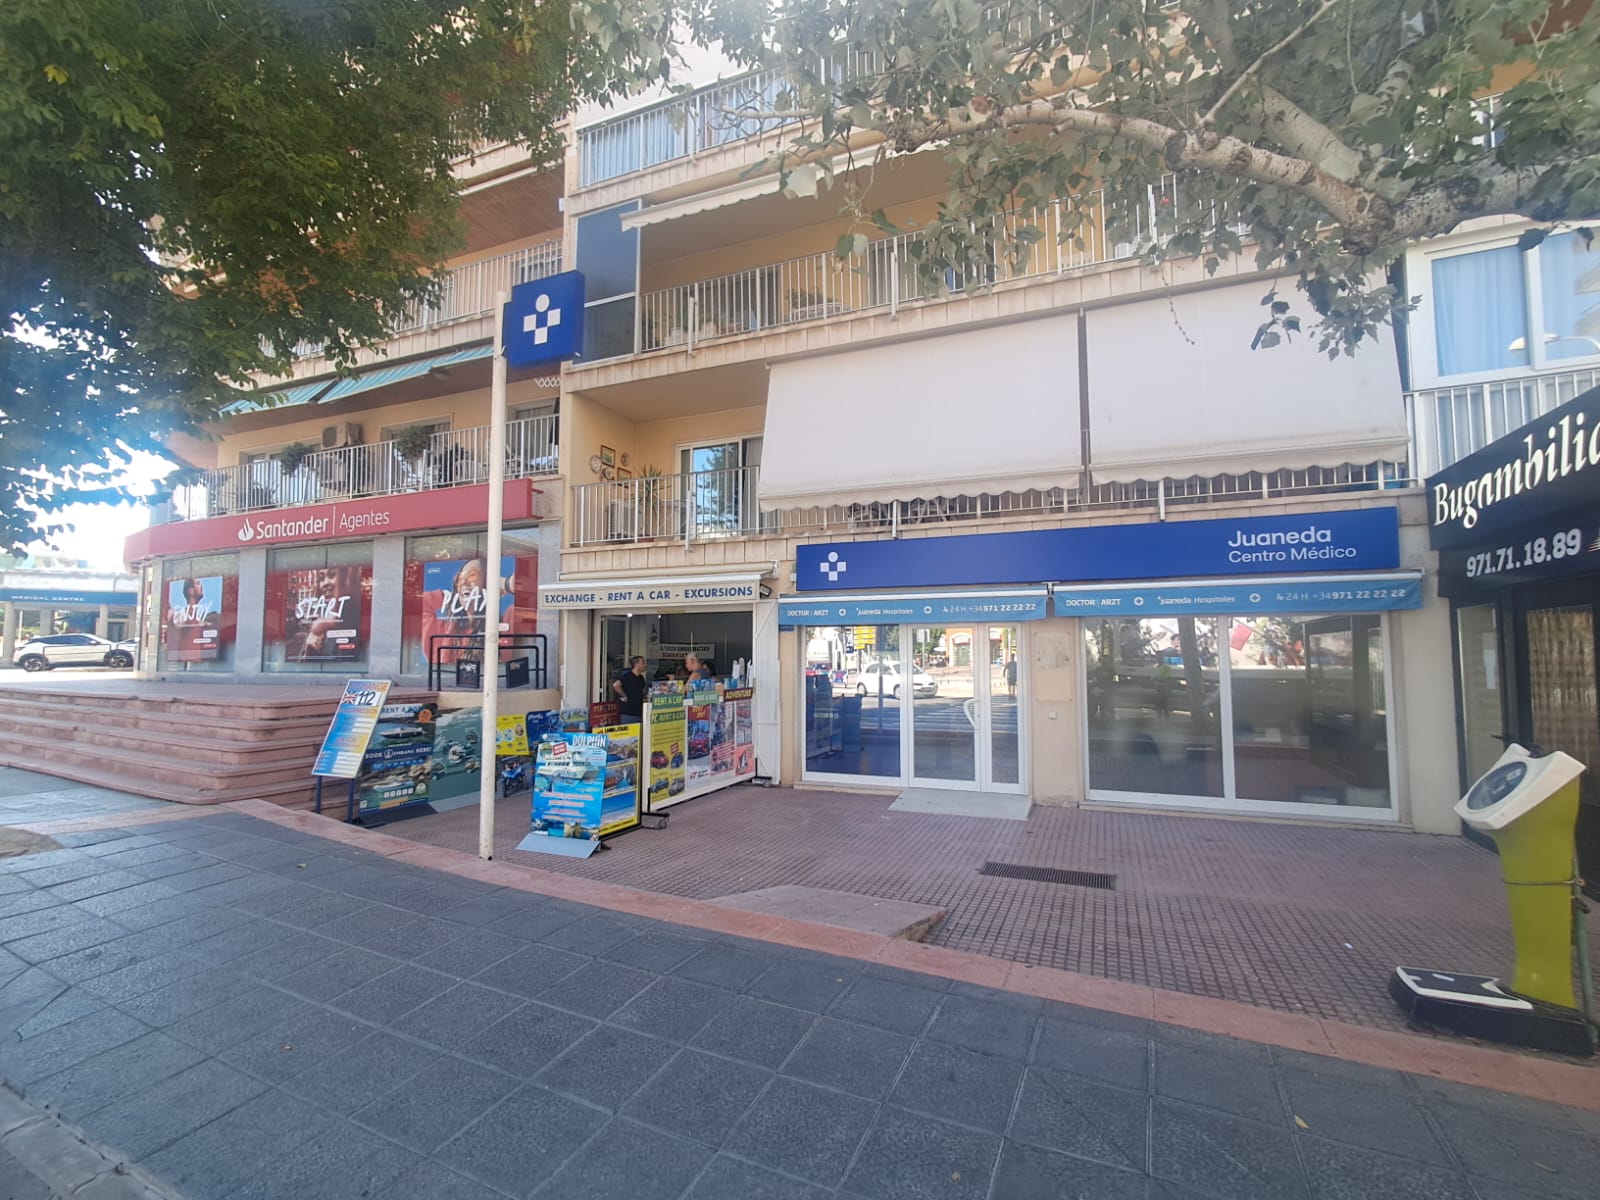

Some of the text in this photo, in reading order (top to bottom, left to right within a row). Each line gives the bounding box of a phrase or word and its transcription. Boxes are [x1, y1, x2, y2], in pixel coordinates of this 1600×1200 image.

[255, 510, 390, 540] Santander Agentes
[1228, 525, 1332, 548] Juaneda
[1228, 545, 1357, 563] Centro Médico
[545, 593, 596, 604] EXCHANGE
[607, 591, 633, 601] RENT
[636, 591, 645, 600] A
[649, 590, 671, 600] CAR
[684, 586, 753, 599] EXCURSIONS
[1066, 599, 1096, 607] DOCTOR
[1101, 598, 1121, 606] ARZT
[1285, 592, 1299, 600] 24
[1356, 590, 1370, 599] 22
[1373, 590, 1387, 598] 22
[1390, 589, 1406, 597] 22
[172, 600, 213, 625] ENJOY
[295, 595, 351, 619] START
[787, 609, 810, 617] DOCTOR
[1012, 603, 1024, 611] 22
[653, 697, 667, 706] RENT
[673, 695, 684, 703] CAR
[725, 689, 752, 699] ADVENTURE
[572, 734, 607, 748] DOLPHIN
